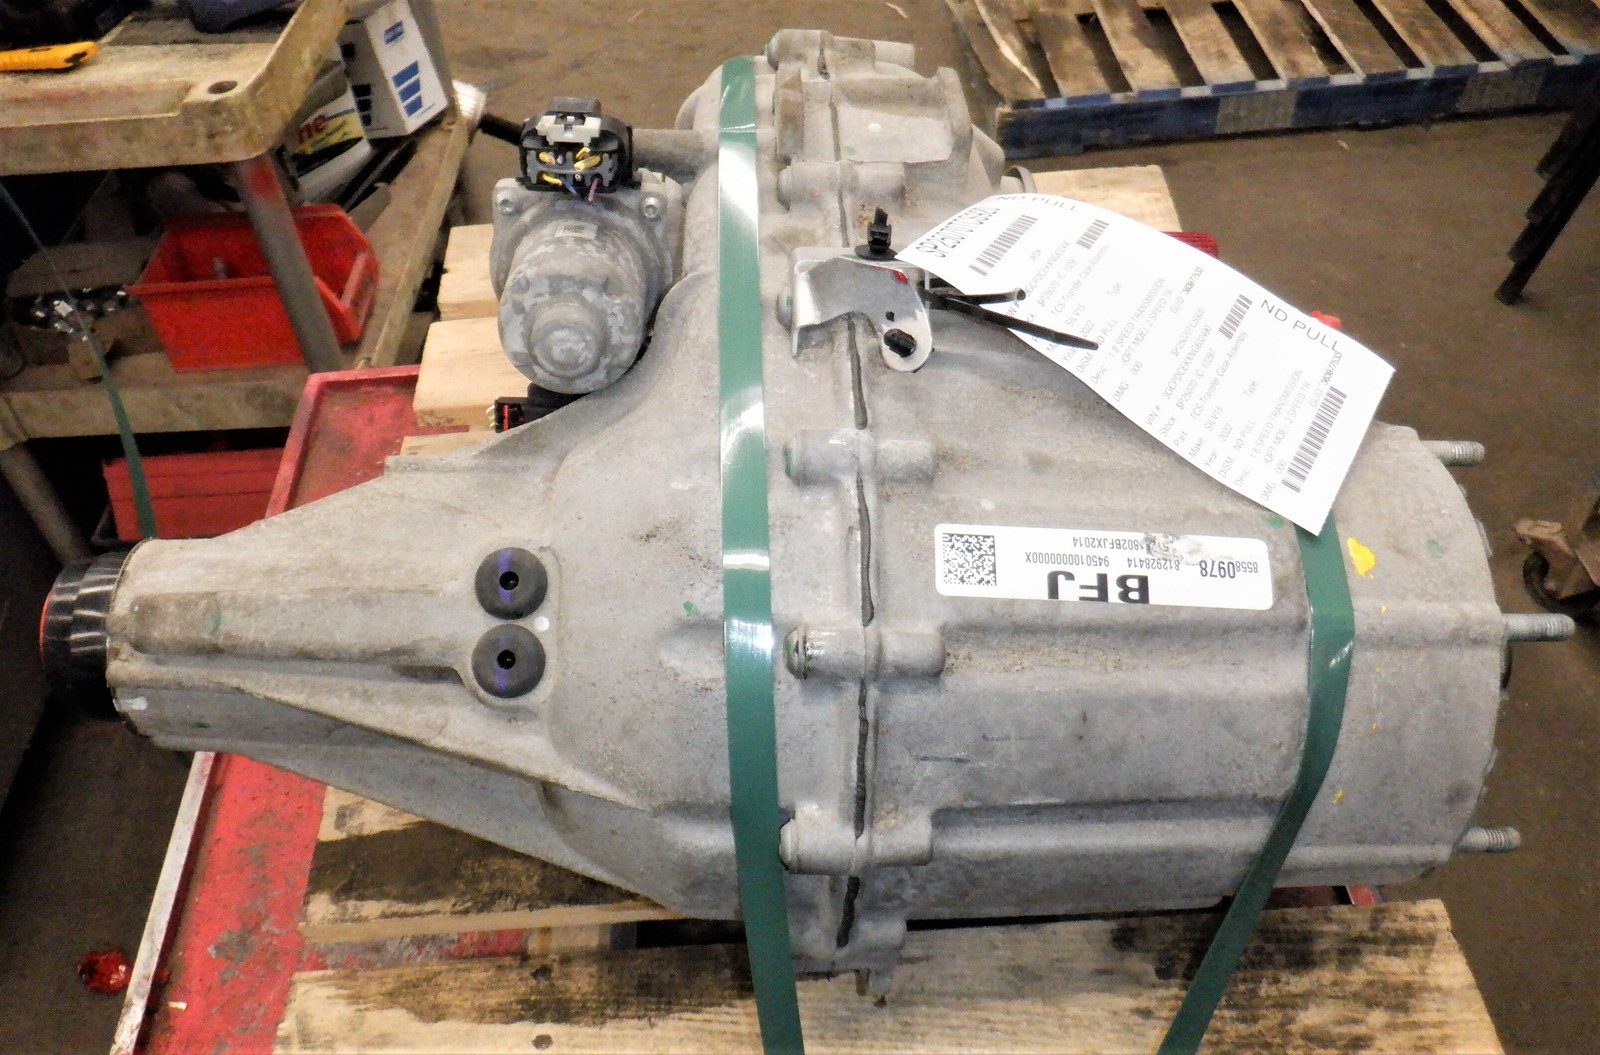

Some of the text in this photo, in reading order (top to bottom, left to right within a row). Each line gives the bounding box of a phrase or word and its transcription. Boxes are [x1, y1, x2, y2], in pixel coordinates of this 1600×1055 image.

[1114, 321, 1136, 347] SPEED
[1130, 277, 1165, 321] TRANSMISSION
[1148, 297, 1168, 321] SPEED
[1078, 319, 1095, 337] 2022
[1100, 319, 1118, 336] PULL
[1260, 299, 1342, 352] ND PULL
[1129, 360, 1143, 376] 000
[1254, 421, 1274, 447] SPEED
[1268, 369, 1303, 421] TRANSMISSION
[1287, 392, 1306, 418] SPEED
[1217, 422, 1233, 442] 2022
[1239, 420, 1256, 439] PULL
[1274, 459, 1287, 474] 000
[1127, 556, 1180, 571] 812928414
[1047, 570, 1150, 604] BFJ
